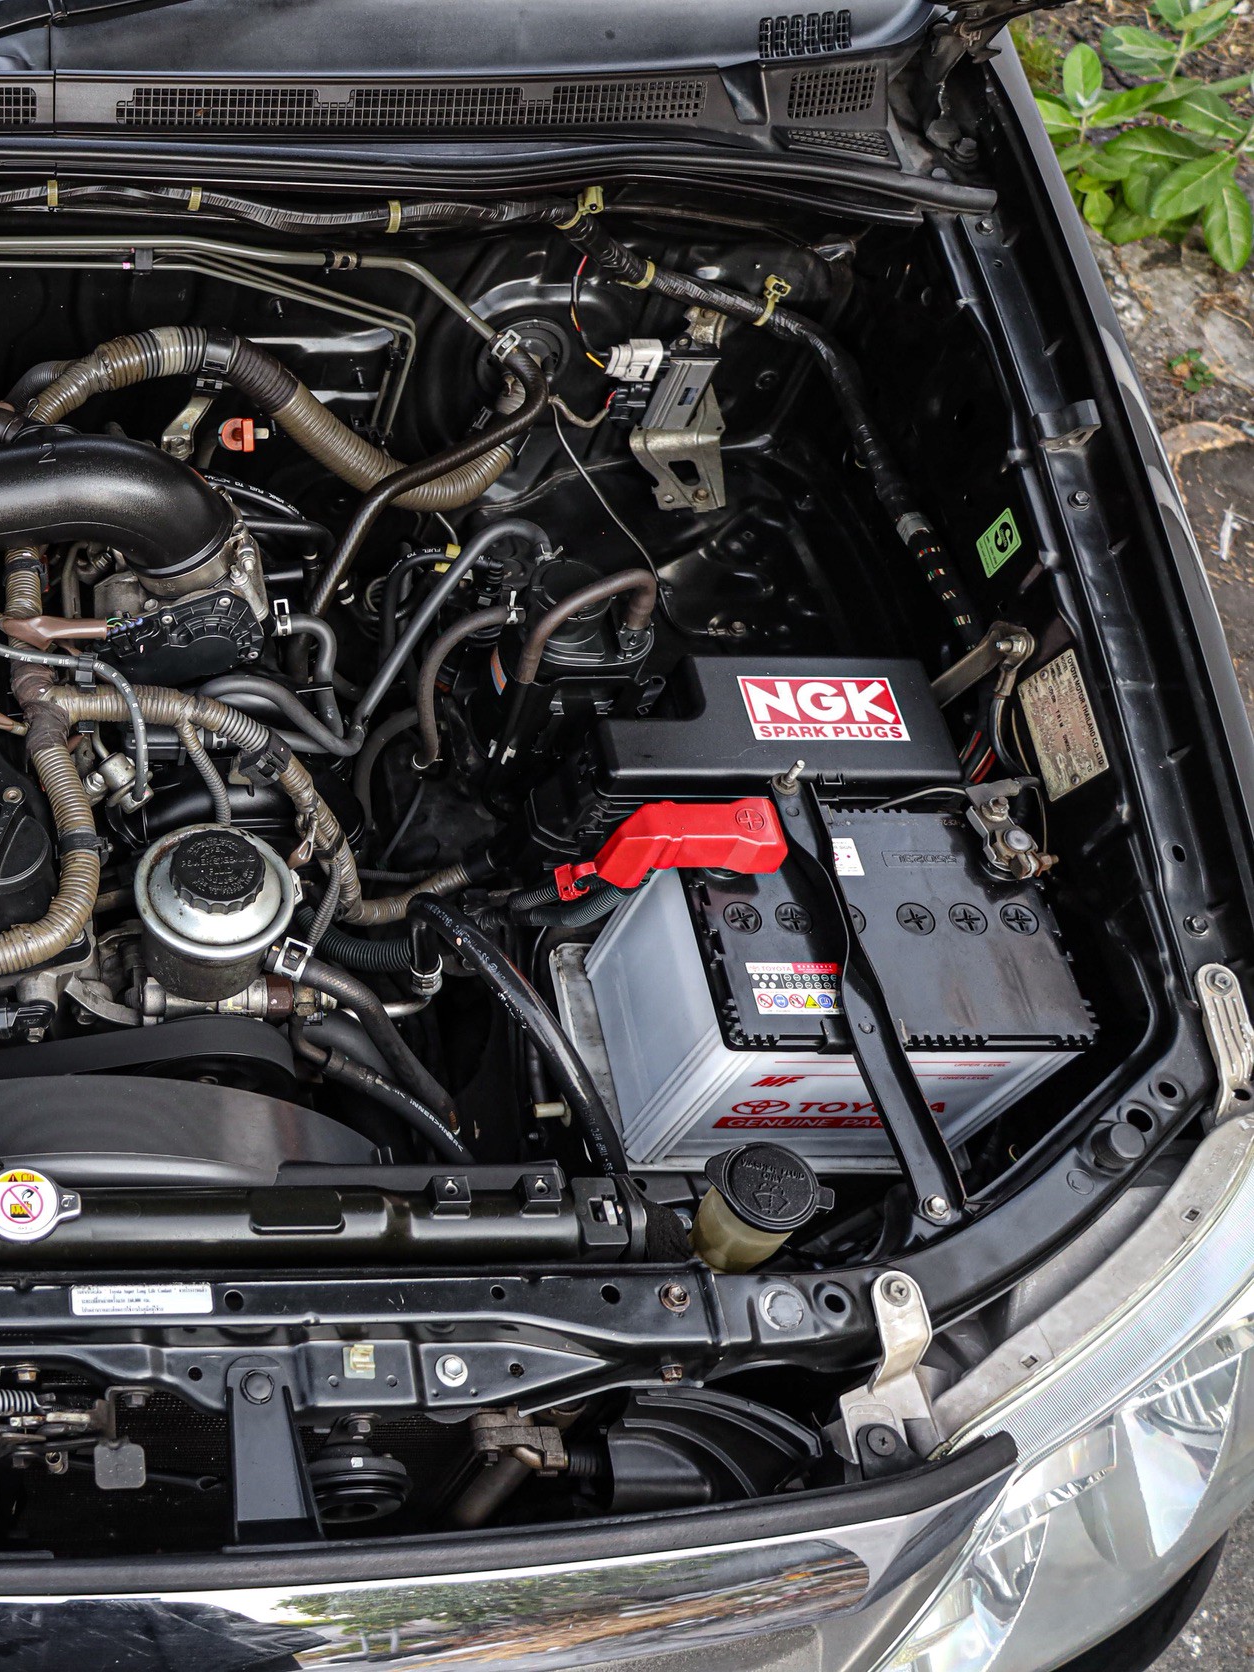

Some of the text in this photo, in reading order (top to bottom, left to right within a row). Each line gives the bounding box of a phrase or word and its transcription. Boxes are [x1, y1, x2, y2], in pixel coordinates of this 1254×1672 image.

[1066, 653, 1077, 681] TOYOTA
[1074, 680, 1086, 704] MOTOR
[1082, 705, 1096, 737] THAILAND
[744, 681, 896, 723] NGK
[759, 726, 903, 738] SPARK PLUGS
[750, 1076, 806, 1087] MF
[799, 1102, 946, 1113] TOYA
[726, 1118, 833, 1127] GENUINE
